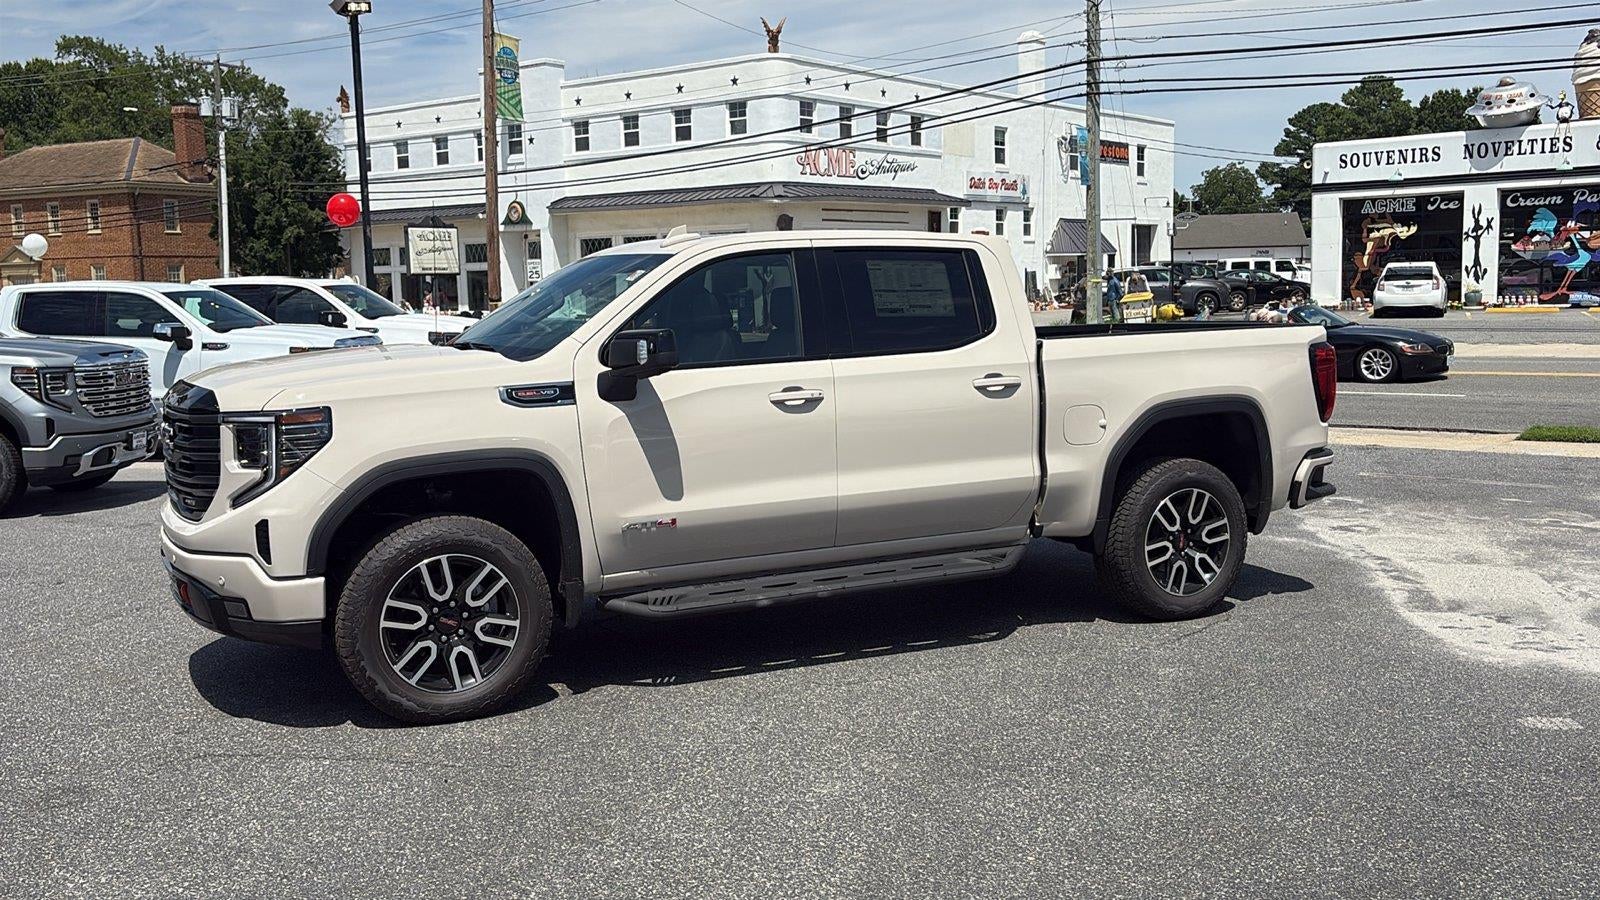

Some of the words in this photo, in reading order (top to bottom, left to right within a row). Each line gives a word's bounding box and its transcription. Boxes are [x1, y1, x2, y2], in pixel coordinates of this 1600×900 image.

[1099, 144, 1129, 160] restone
[1339, 146, 1442, 170] SOUVENIRS
[1463, 136, 1573, 160] NOVELTIES
[797, 147, 857, 179] ACME
[856, 152, 918, 181] Antiques
[969, 176, 986, 190] Dutch
[988, 177, 1000, 194] Boy
[1000, 178, 1018, 191] Paints
[1361, 197, 1416, 214] ACME
[1427, 196, 1461, 211] Ice
[1506, 192, 1564, 208] Cream
[528, 270, 541, 279] 25
